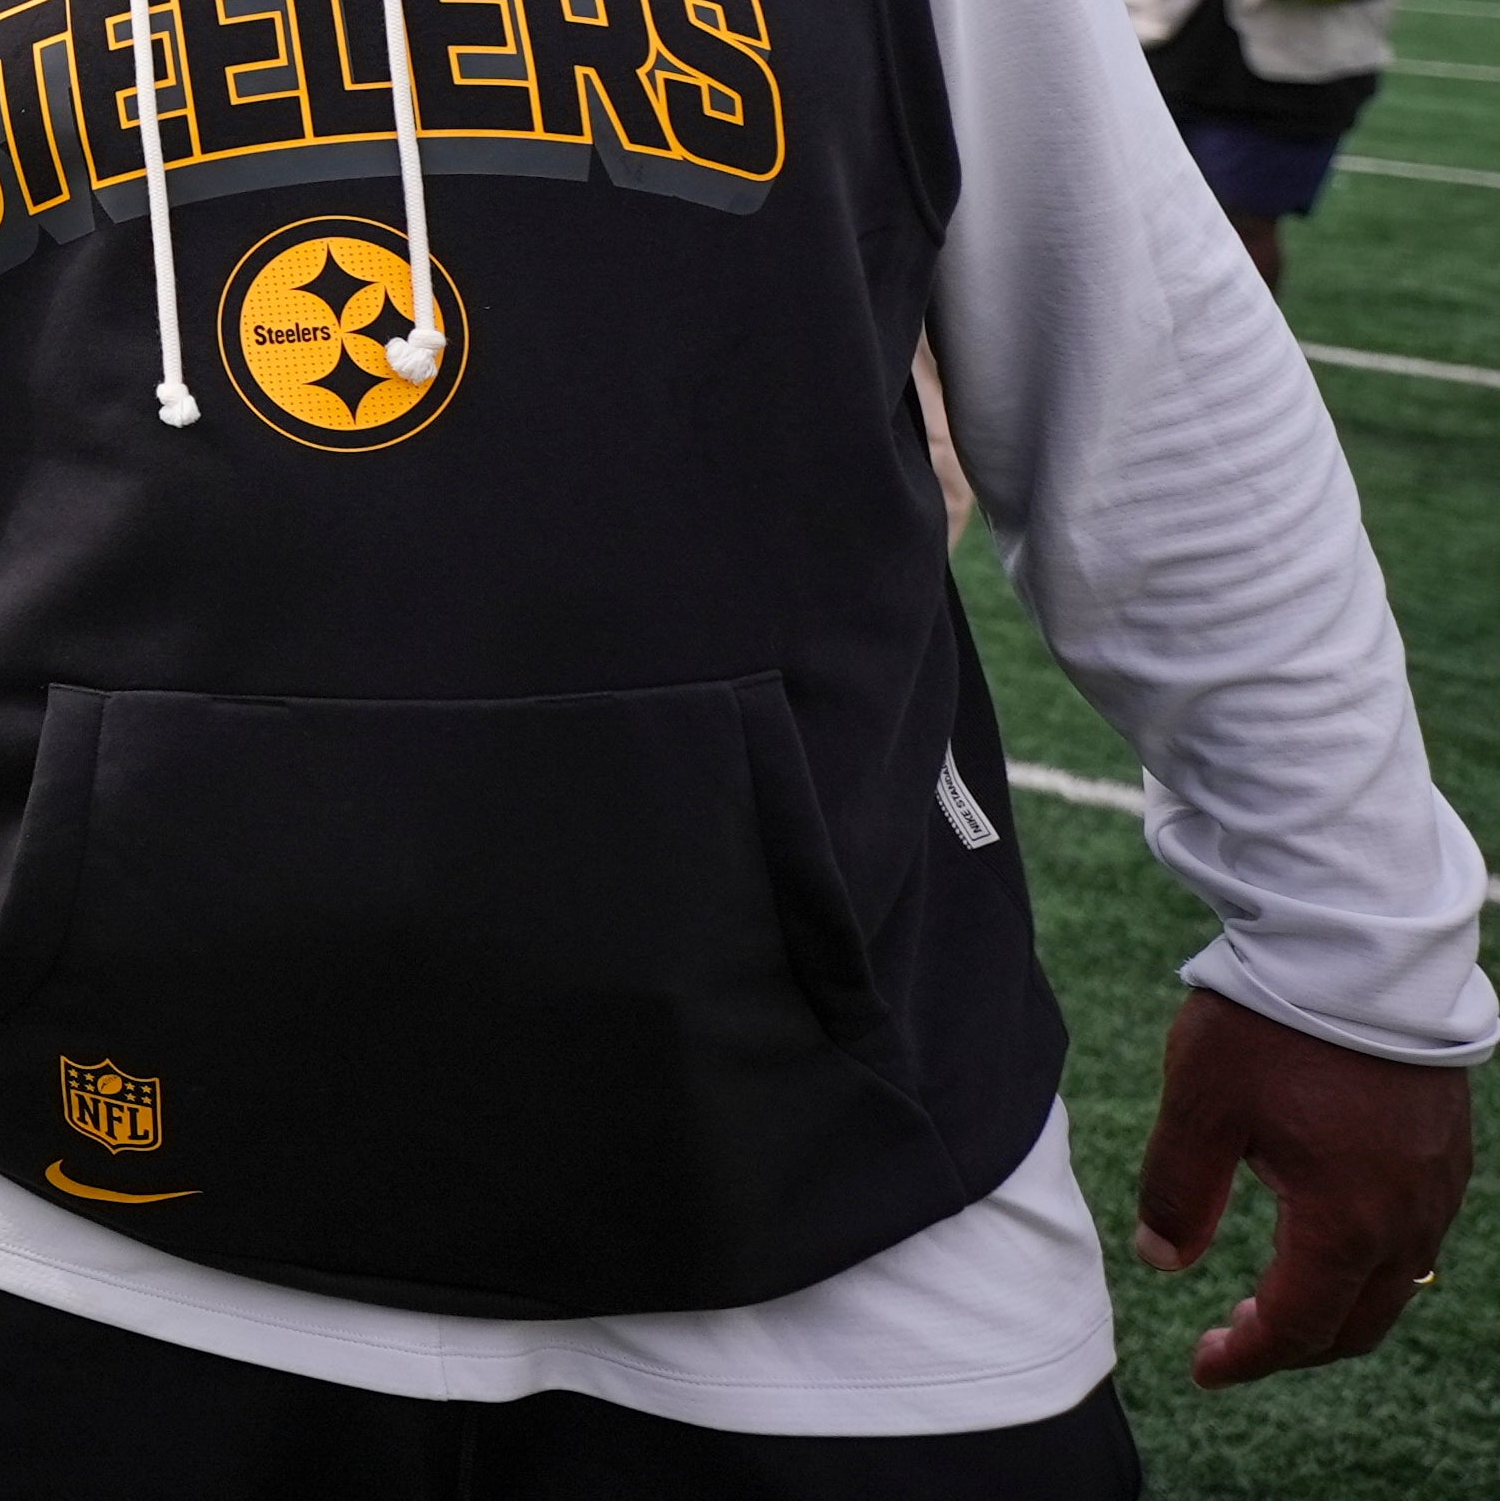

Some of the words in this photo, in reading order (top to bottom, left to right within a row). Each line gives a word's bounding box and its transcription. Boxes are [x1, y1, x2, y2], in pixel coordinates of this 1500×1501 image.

[253, 322, 332, 346] Steelers
[960, 808, 983, 834] NIKE
[73, 1091, 151, 1142] NFL
